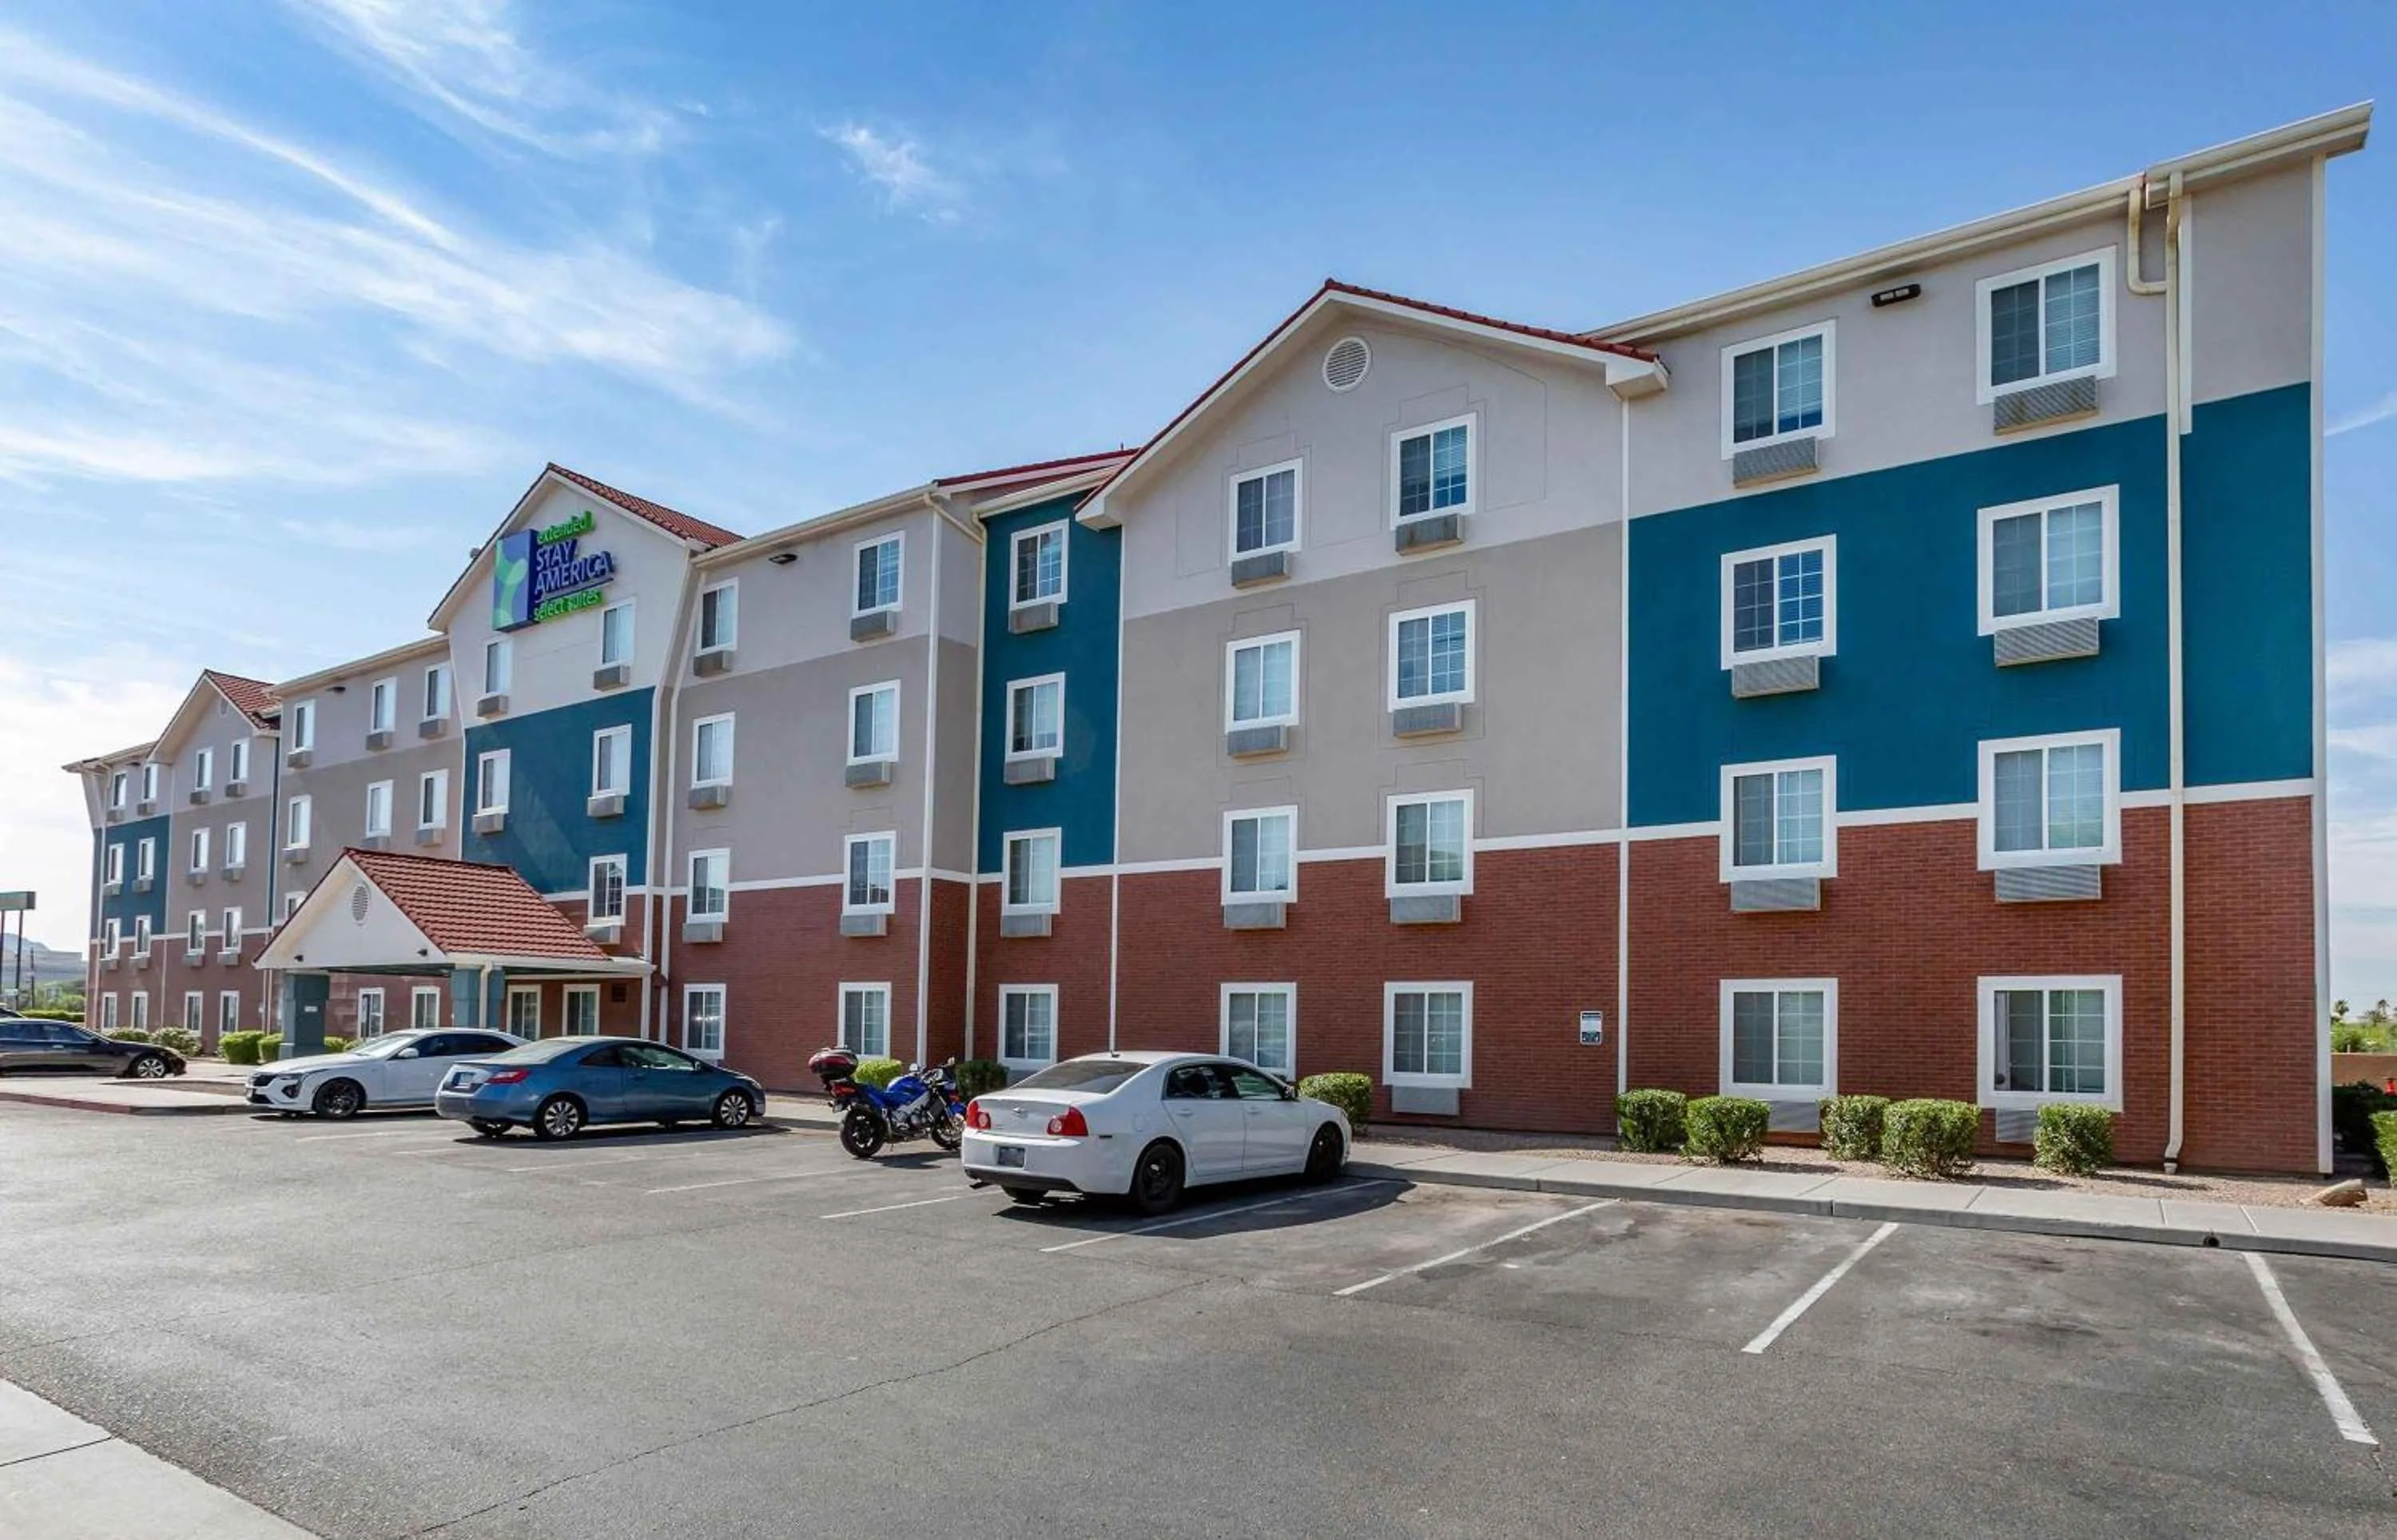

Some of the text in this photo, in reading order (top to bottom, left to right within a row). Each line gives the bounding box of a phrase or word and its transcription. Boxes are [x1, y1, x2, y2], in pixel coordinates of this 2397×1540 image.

[537, 510, 593, 544] extended
[536, 540, 575, 571] STAY
[535, 551, 612, 594] AMERICA
[534, 589, 602, 621] select suites
